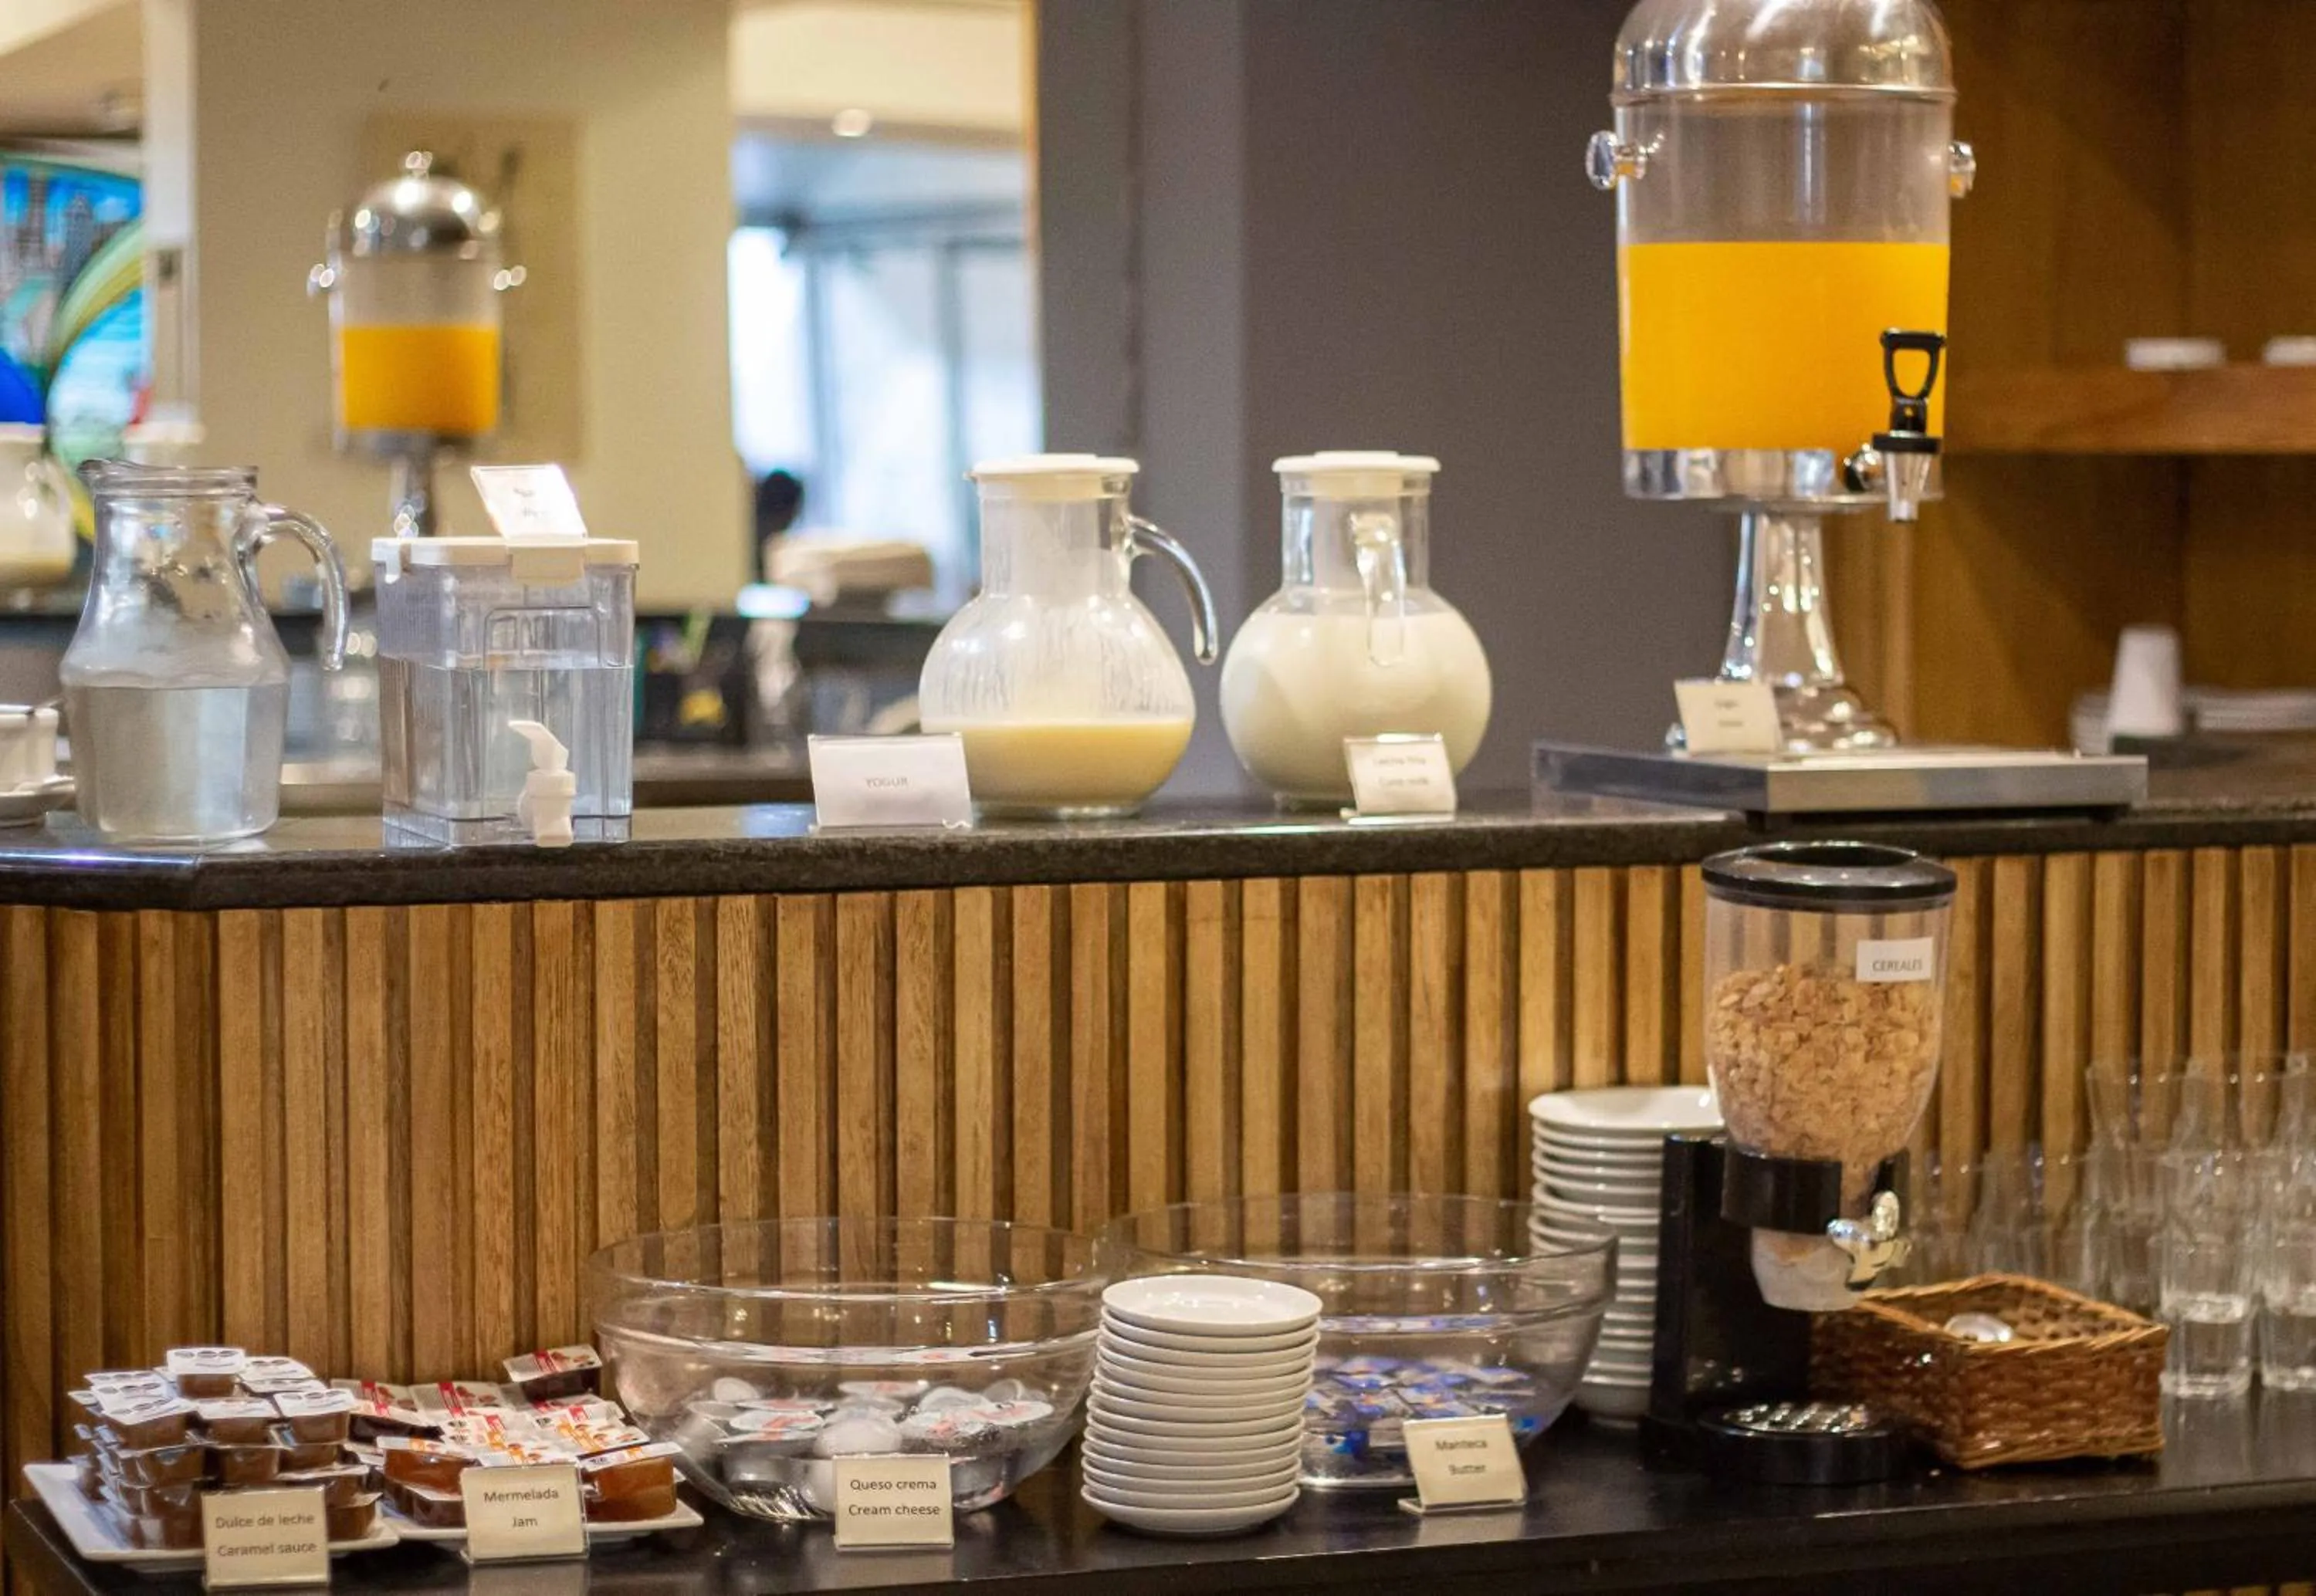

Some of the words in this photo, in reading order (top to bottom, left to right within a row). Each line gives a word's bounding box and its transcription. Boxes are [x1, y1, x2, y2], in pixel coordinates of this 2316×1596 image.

[865, 777, 908, 788] YOGUR
[1435, 1439, 1488, 1450] Manteca
[849, 1479, 893, 1492] Queso
[896, 1480, 937, 1490] crema
[483, 1487, 559, 1503] Mermelada
[848, 1503, 892, 1517] Cream
[895, 1503, 940, 1516] cheese
[215, 1515, 255, 1530] Dulce
[257, 1514, 275, 1527] de
[278, 1513, 315, 1526] leche
[512, 1516, 538, 1528] Jam
[217, 1543, 274, 1557] Caramel
[278, 1542, 317, 1554] sauce
